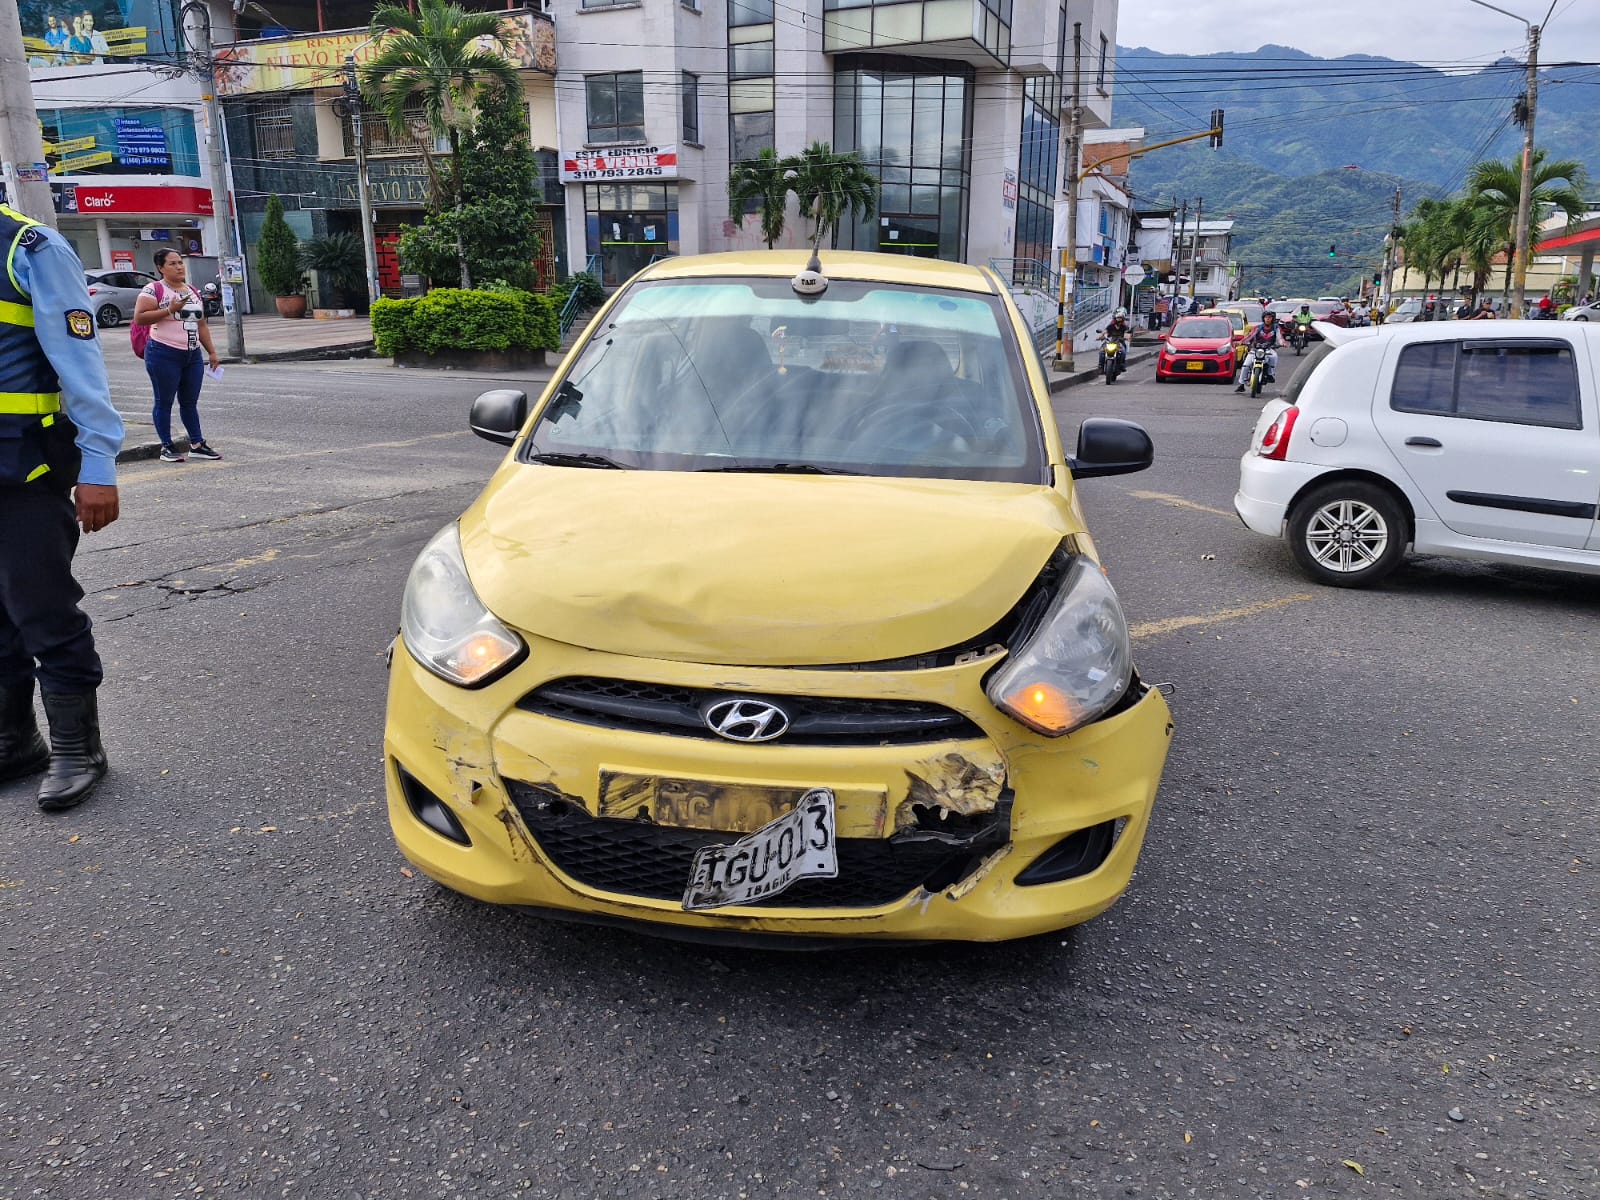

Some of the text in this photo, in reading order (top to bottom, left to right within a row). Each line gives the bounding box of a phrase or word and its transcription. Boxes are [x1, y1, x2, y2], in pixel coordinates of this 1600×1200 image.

[266, 50, 329, 71] NUEVO
[575, 147, 659, 159] ESTE EDIFICIO
[577, 154, 659, 171] SE VENDE
[573, 166, 663, 179] 310 793 2845
[84, 194, 112, 207] Claro
[745, 868, 793, 898] IBAGUE
